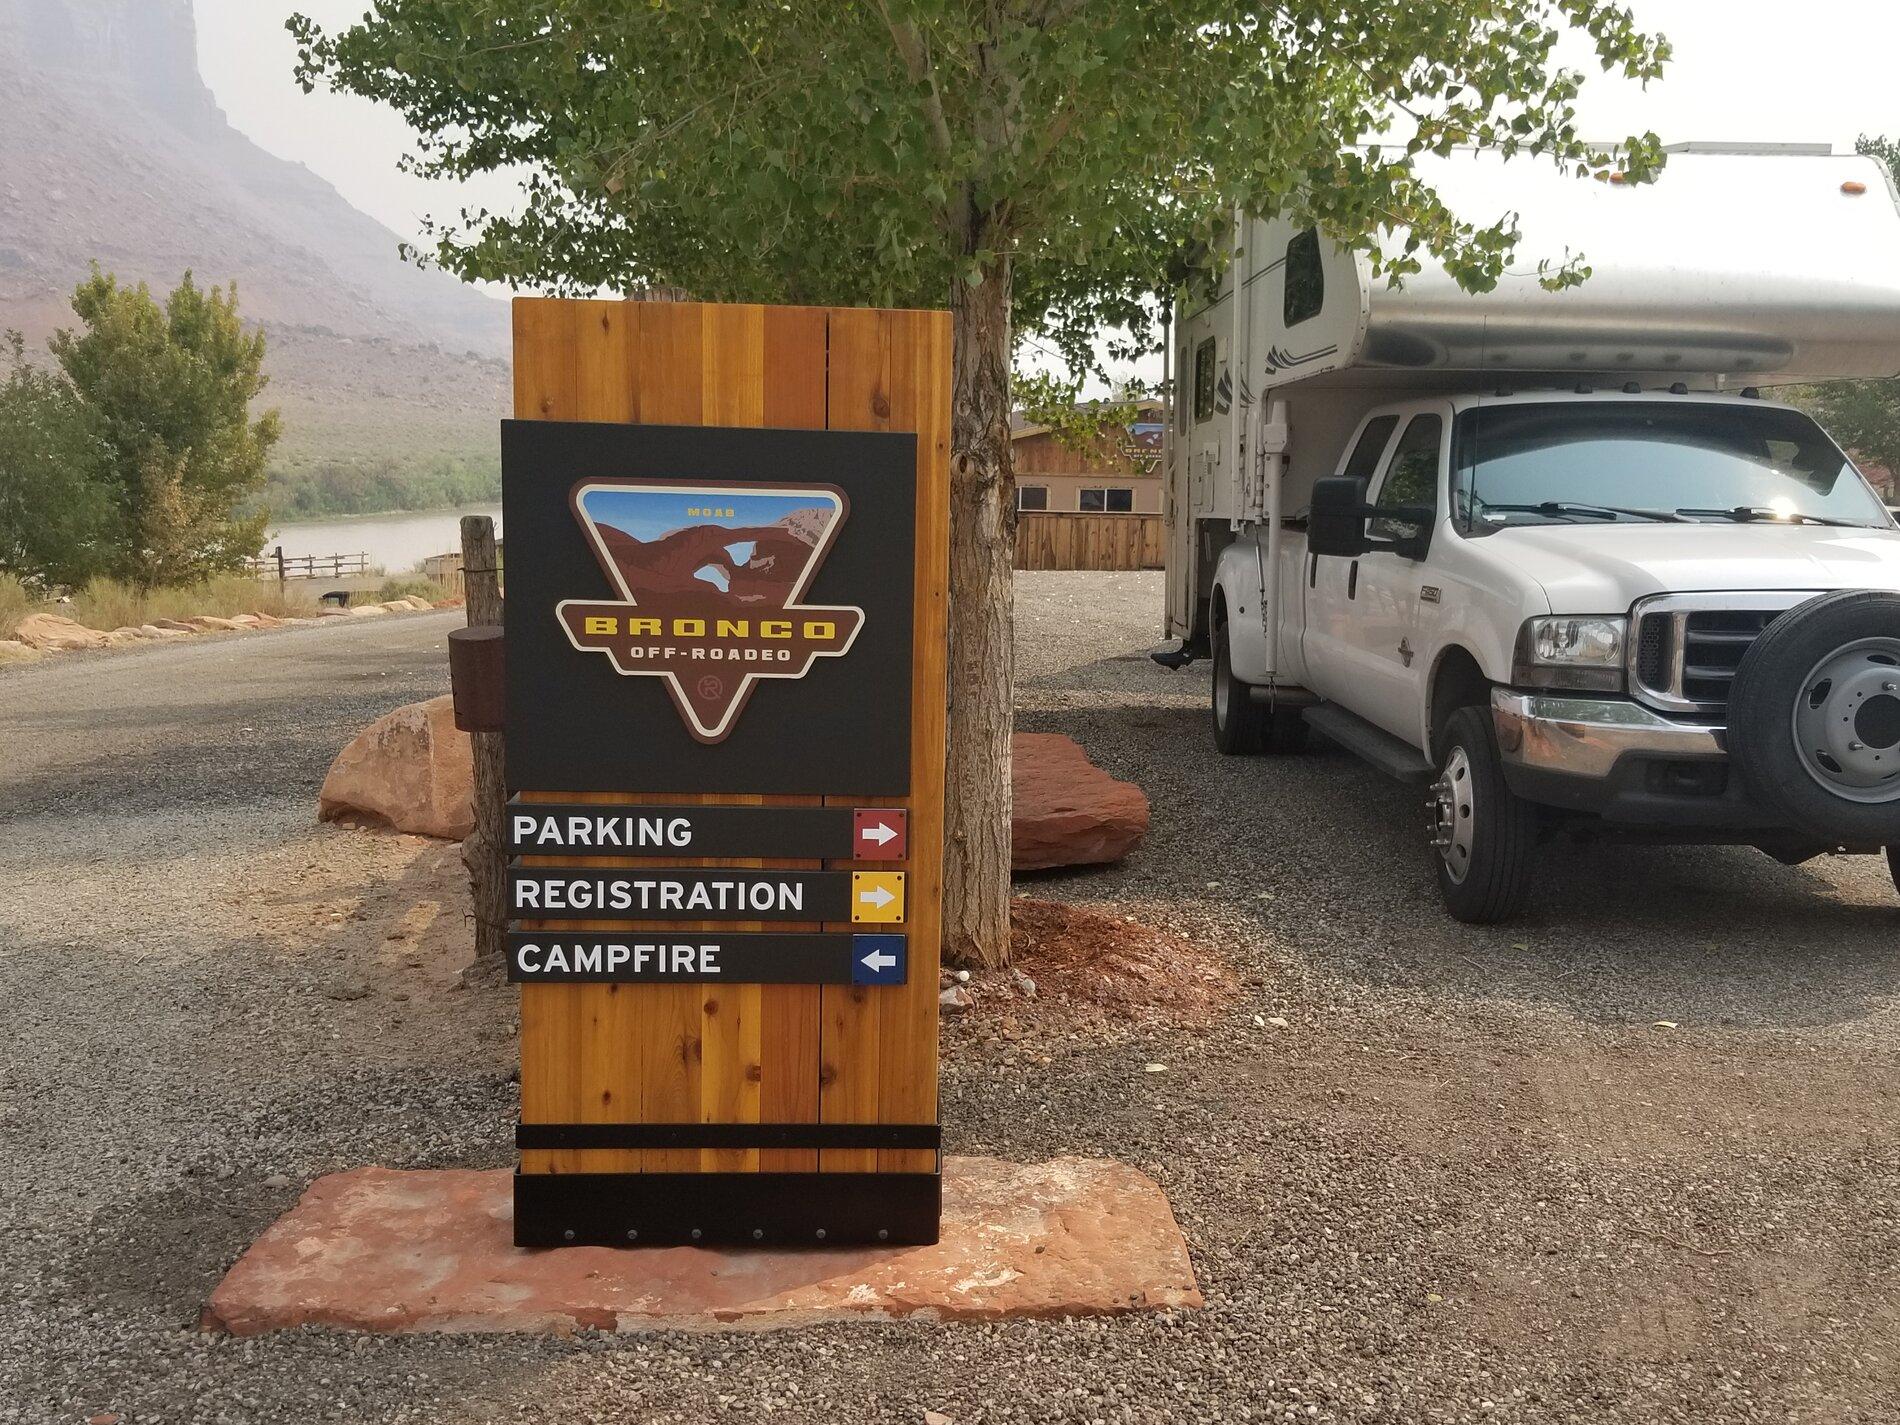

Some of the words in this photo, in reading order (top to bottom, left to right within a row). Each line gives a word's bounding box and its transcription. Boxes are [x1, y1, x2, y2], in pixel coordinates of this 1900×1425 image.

[687, 507, 736, 518] MOAB
[584, 617, 836, 640] BRONCO
[630, 646, 791, 662] OFF-ROADEO
[513, 815, 692, 847] PARKING
[515, 879, 803, 911] REGISTRATION
[517, 943, 721, 974] CAMPFIRE
